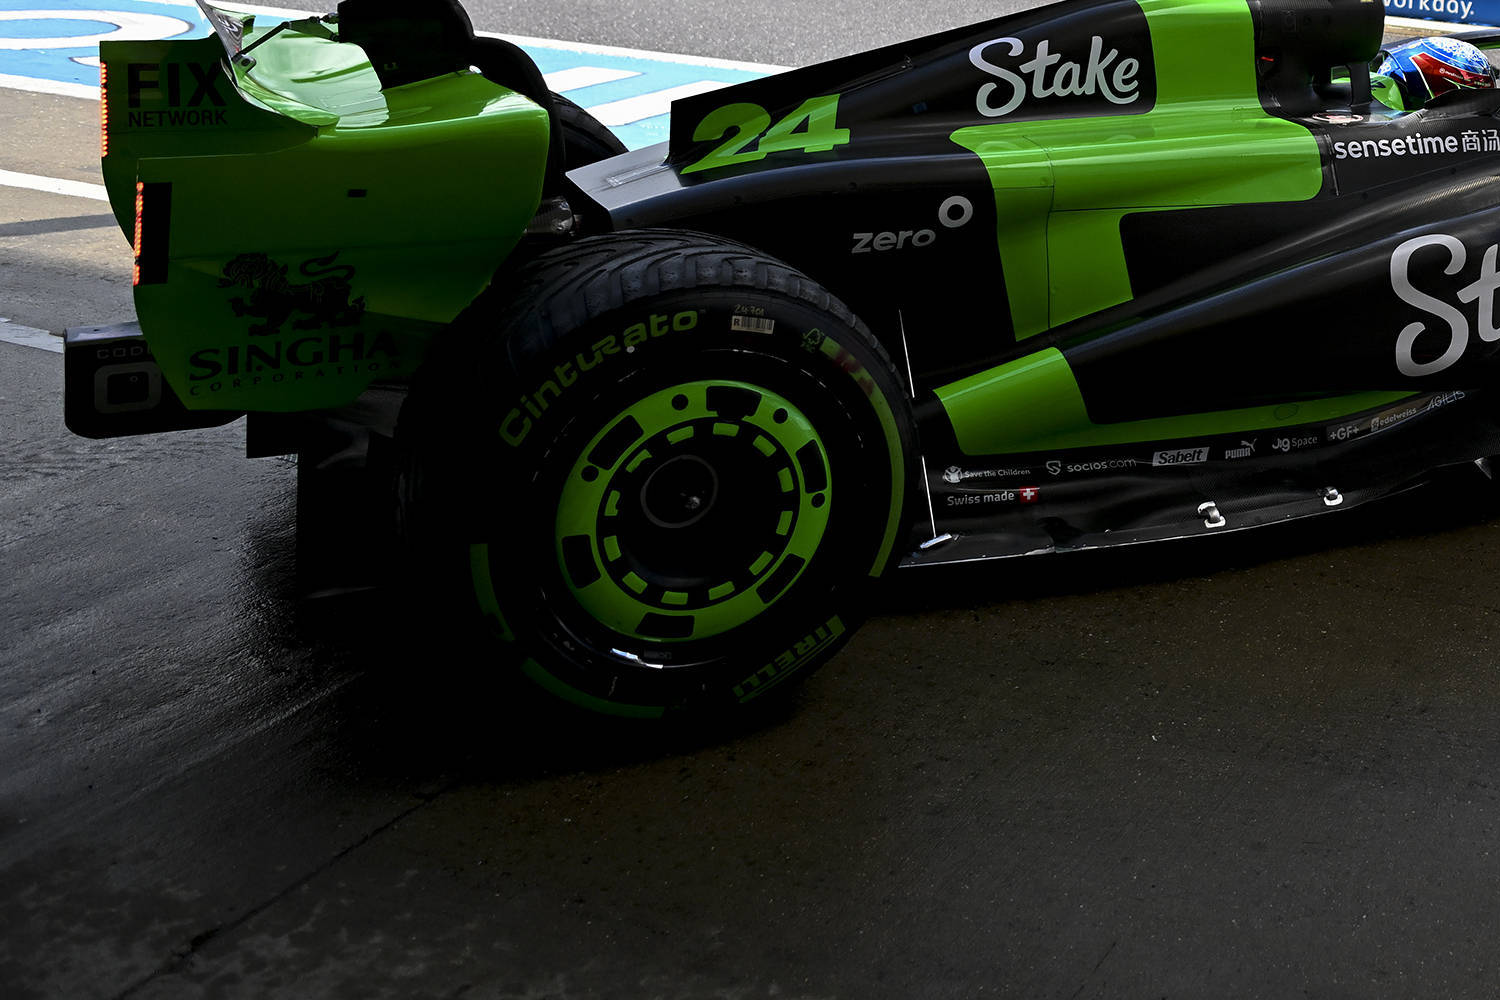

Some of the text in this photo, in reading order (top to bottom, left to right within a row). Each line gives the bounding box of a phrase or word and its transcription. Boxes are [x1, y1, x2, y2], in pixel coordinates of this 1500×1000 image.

[127, 62, 226, 108] FIX
[968, 36, 1140, 117] Stake
[128, 110, 229, 128] NETWORK
[679, 93, 850, 175] 24
[1333, 132, 1458, 160] sensetime
[1461, 129, 1500, 153] 商汤
[189, 331, 401, 381] SINGHA
[189, 361, 401, 396] CORPORATION
[1380, 407, 1417, 427] edelweiss
[1066, 457, 1137, 473] socios.com
[1158, 448, 1204, 465] Sabelt
[997, 468, 1031, 477] Children
[947, 491, 1015, 506] Swiss made
